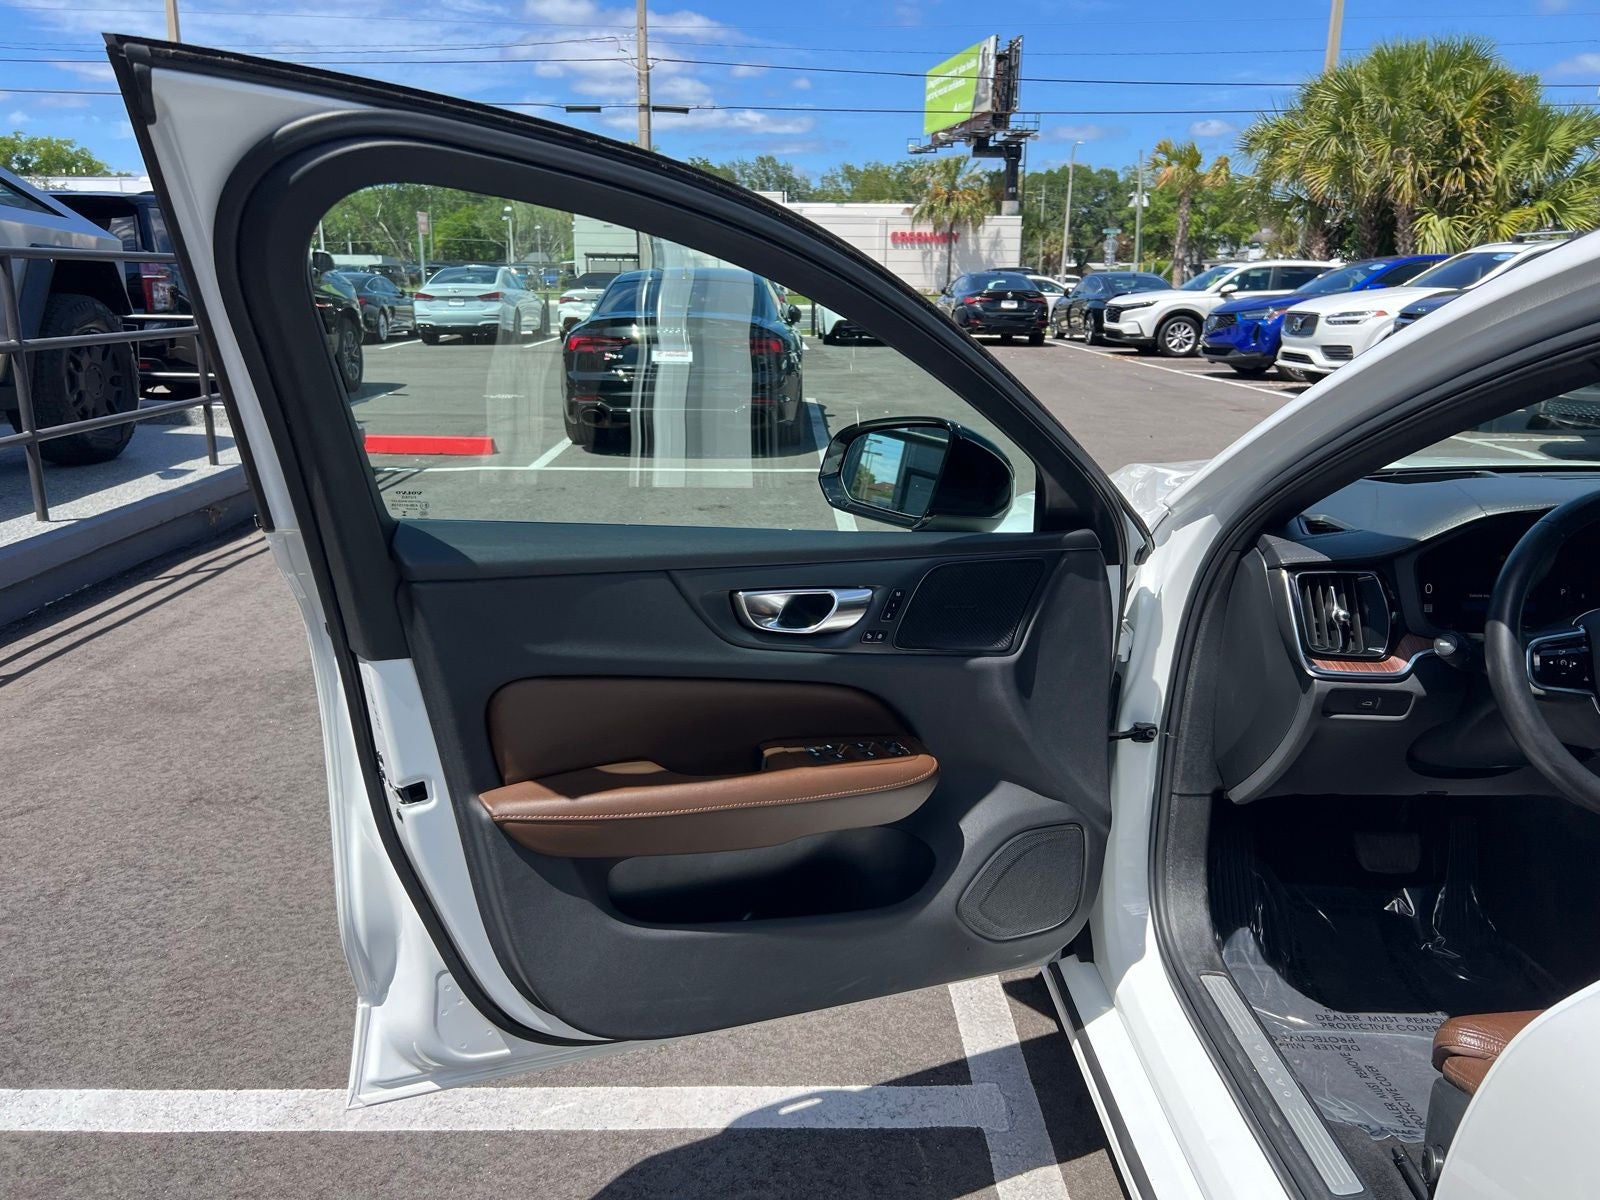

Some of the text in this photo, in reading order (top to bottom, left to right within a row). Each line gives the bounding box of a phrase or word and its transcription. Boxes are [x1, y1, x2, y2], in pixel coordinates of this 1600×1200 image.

[1314, 1013, 1361, 1022] DEALER
[1367, 1015, 1399, 1023] MUST
[1320, 1021, 1394, 1031] PROTECTIVE
[1313, 1043, 1361, 1052] DEALER
[1253, 1043, 1292, 1098] VOLVO
[1340, 1052, 1370, 1079] REMOVE
[1364, 1064, 1392, 1087] COVER
[1365, 1081, 1389, 1099] MUST
